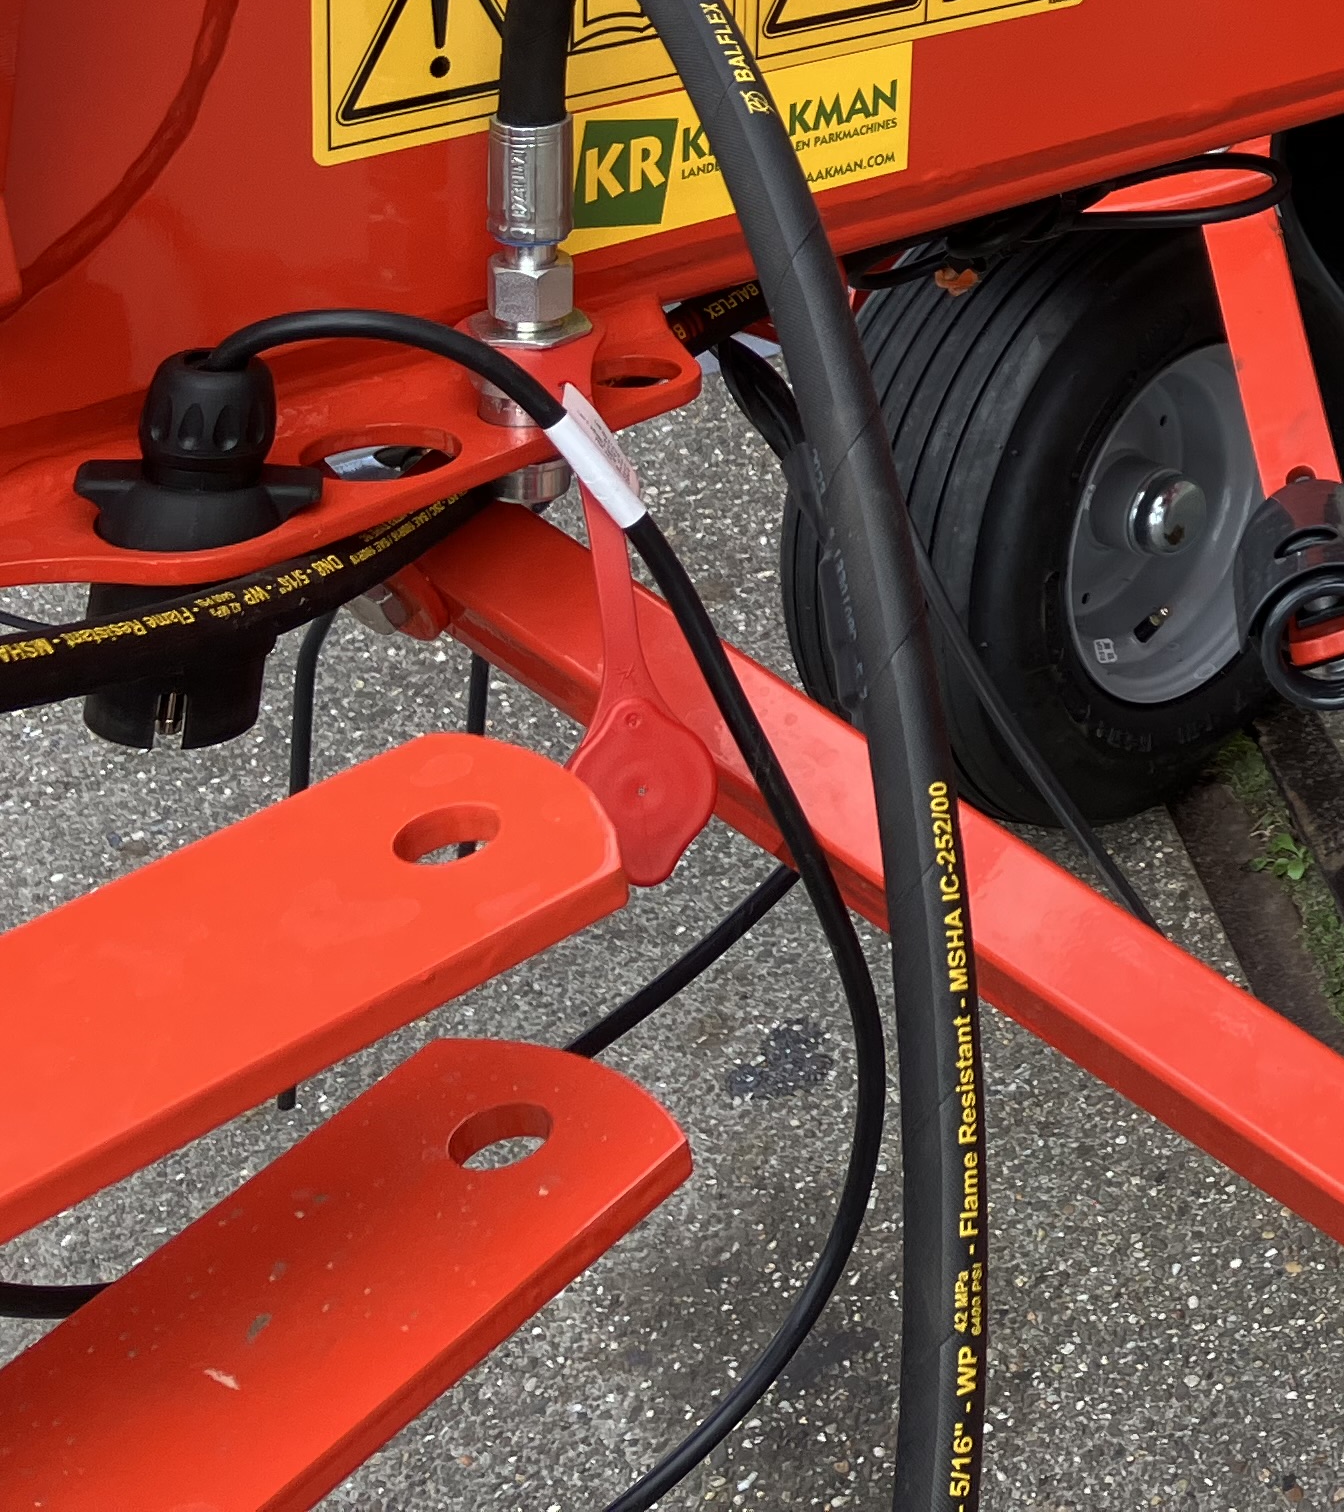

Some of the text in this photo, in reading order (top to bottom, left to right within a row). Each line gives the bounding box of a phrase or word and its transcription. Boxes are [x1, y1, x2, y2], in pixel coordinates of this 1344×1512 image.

[699, 2, 757, 83] BALFLEX
[795, 138, 812, 152] EN
[814, 117, 898, 148] PARKMACHINES
[584, 135, 666, 205] KR
[703, 283, 760, 320] BALFLEX
[143, 607, 196, 629] Flame
[243, 584, 271, 605] WP
[60, 619, 147, 648] Resistant
[928, 781, 961, 903] IC-252/00
[944, 907, 969, 993] MSHA
[953, 1014, 978, 1146] Resistant
[959, 1151, 980, 1239] Flame
[954, 1269, 970, 1309] MPa
[954, 1309, 969, 1334] 42
[956, 1345, 979, 1397] WP
[949, 1422, 973, 1498] 5/16"
